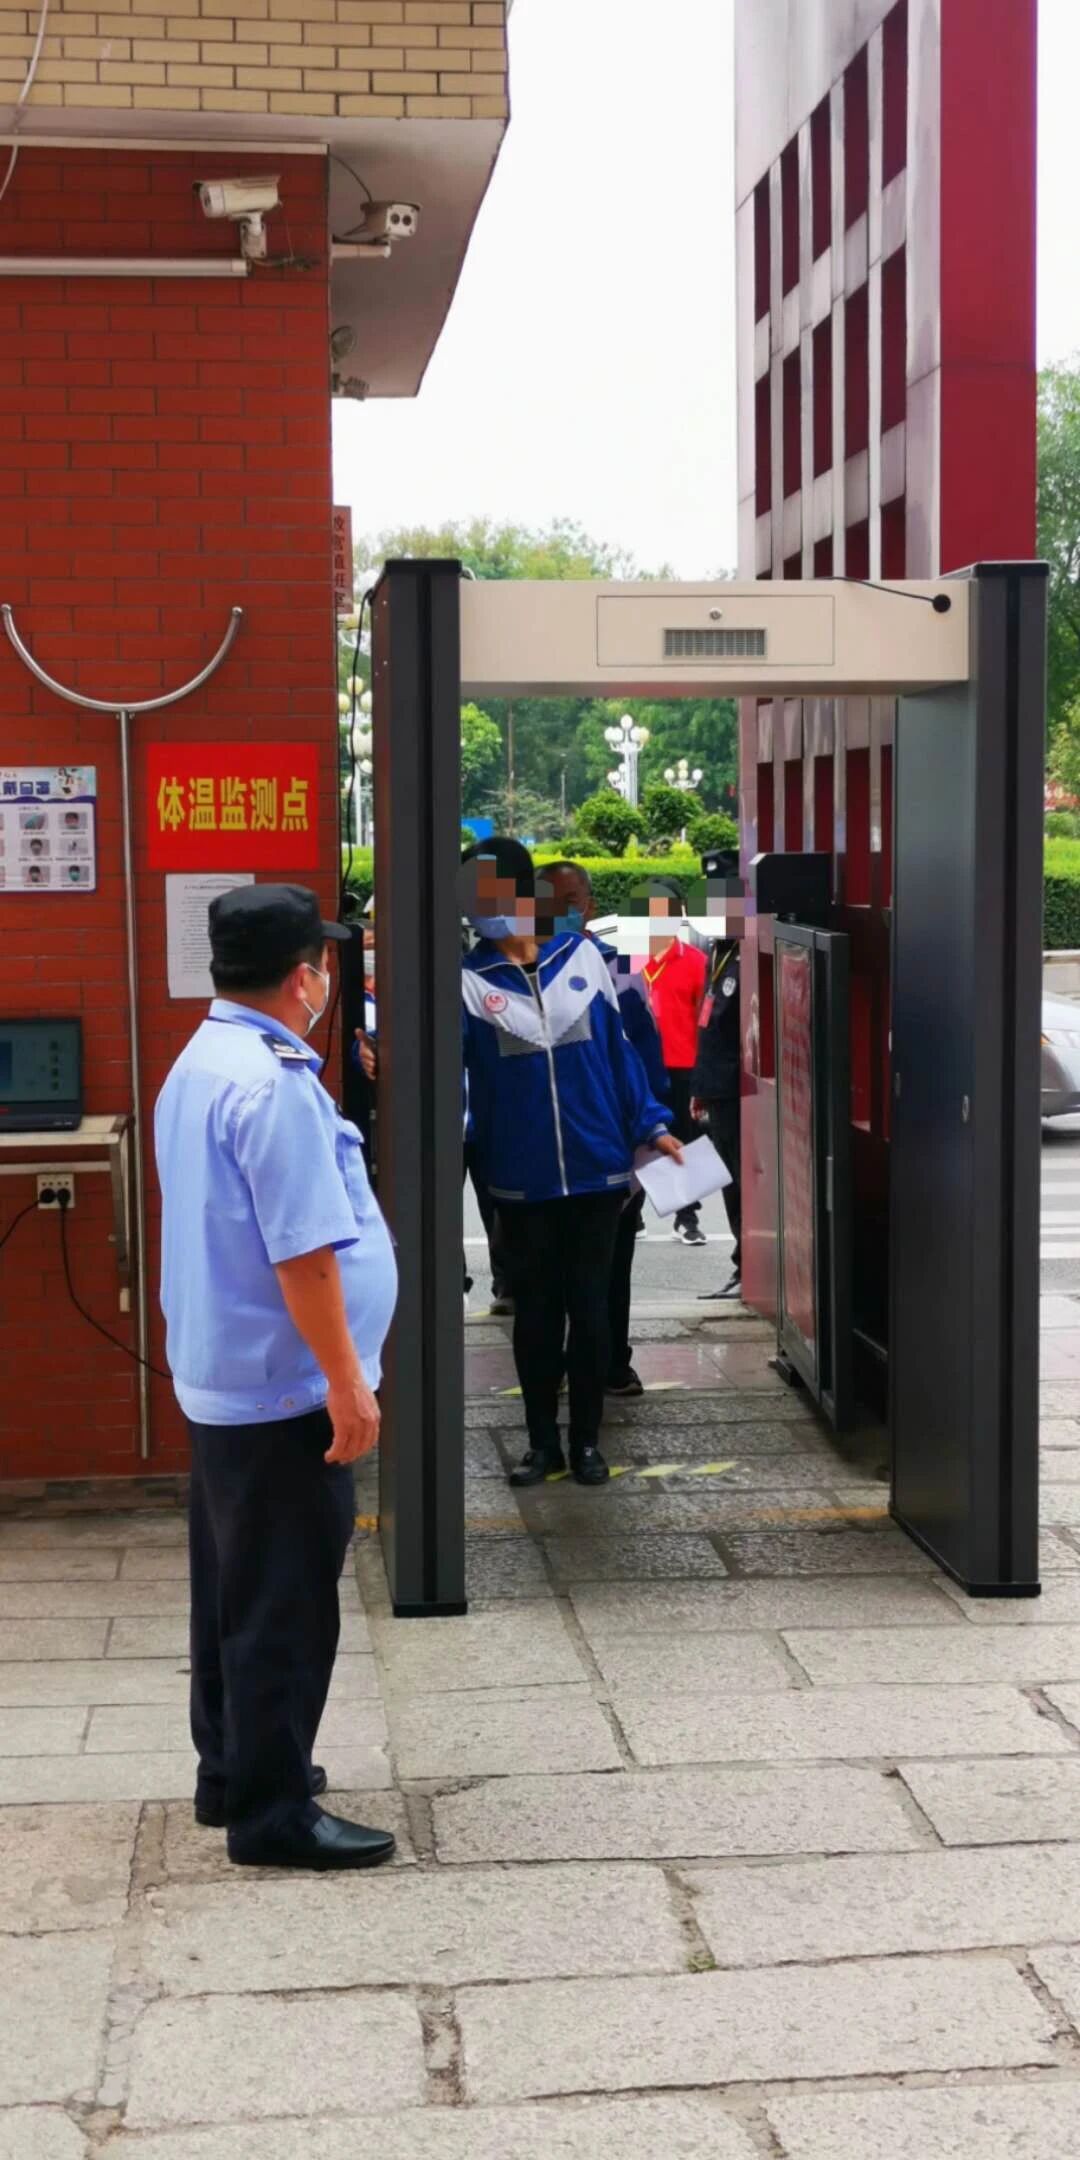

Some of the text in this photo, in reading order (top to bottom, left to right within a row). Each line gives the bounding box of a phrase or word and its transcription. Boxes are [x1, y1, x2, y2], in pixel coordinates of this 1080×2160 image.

[157, 776, 309, 832] 体温监测点
